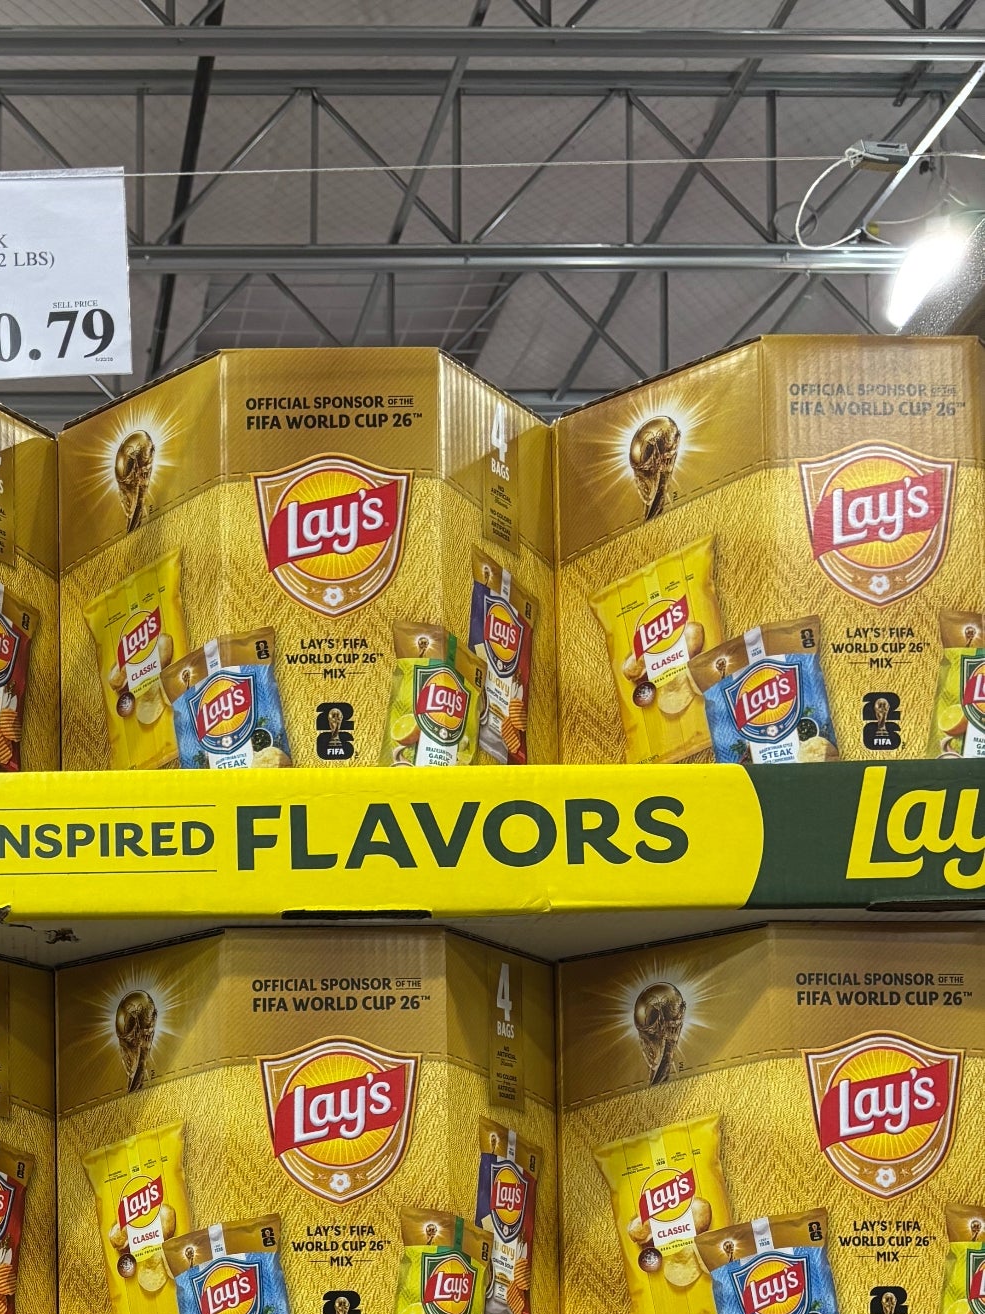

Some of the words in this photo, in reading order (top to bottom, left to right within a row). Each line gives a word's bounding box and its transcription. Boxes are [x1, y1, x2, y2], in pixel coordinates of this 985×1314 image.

[14, 251, 55, 269] LBS)
[52, 301, 72, 309] SELL
[75, 300, 98, 308] PRICE
[245, 397, 310, 410] OFFICIAL
[314, 395, 384, 408] SPONSOR
[387, 397, 398, 406] OF
[400, 396, 414, 405] THE
[247, 415, 281, 431] FIFA
[286, 414, 351, 429] WORLD
[355, 414, 389, 428] CUP
[832, 477, 930, 546] Lay's
[287, 489, 385, 558] Lay's
[343, 638, 368, 650] FIFA
[286, 652, 331, 665] WORLD
[335, 652, 359, 664] CUP
[651, 649, 685, 671] CLASSIC
[323, 667, 346, 680] MIX
[237, 796, 689, 872] FLAVORS
[293, 1073, 392, 1142] Lay's
[840, 1067, 936, 1137] Lay's
[644, 1175, 691, 1214] Lay's
[657, 1223, 691, 1239] CLASSIC
[750, 1269, 799, 1307] Lay's
